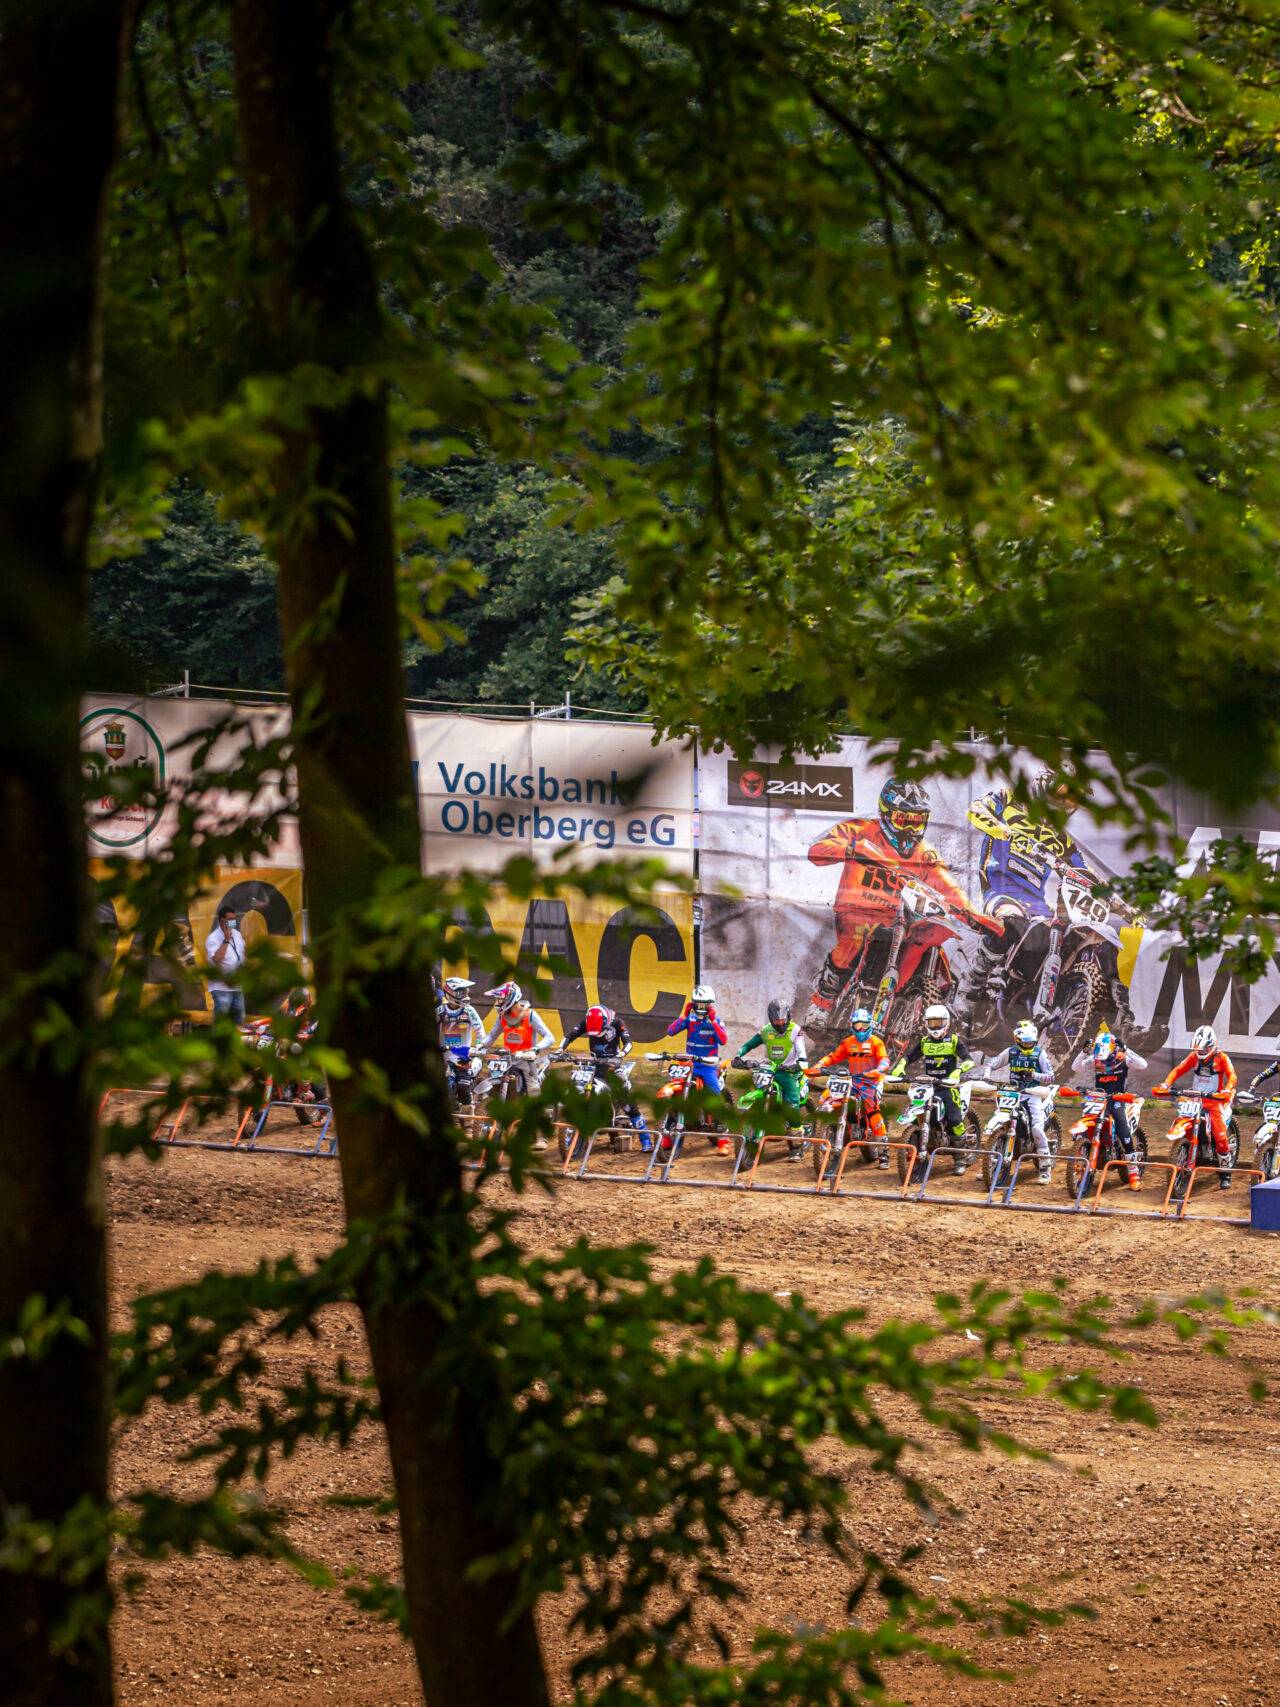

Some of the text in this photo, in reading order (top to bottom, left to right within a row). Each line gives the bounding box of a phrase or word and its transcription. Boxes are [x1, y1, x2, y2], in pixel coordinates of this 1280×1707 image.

[438, 761, 626, 806] Volksbank
[767, 781, 843, 797] 24MX
[441, 800, 675, 850] Oberberg eG
[1068, 888, 1110, 923] 149
[669, 1064, 691, 1078] 252
[913, 1088, 927, 1099] 3
[1082, 1101, 1105, 1114] 72
[1177, 1101, 1201, 1114] 300
